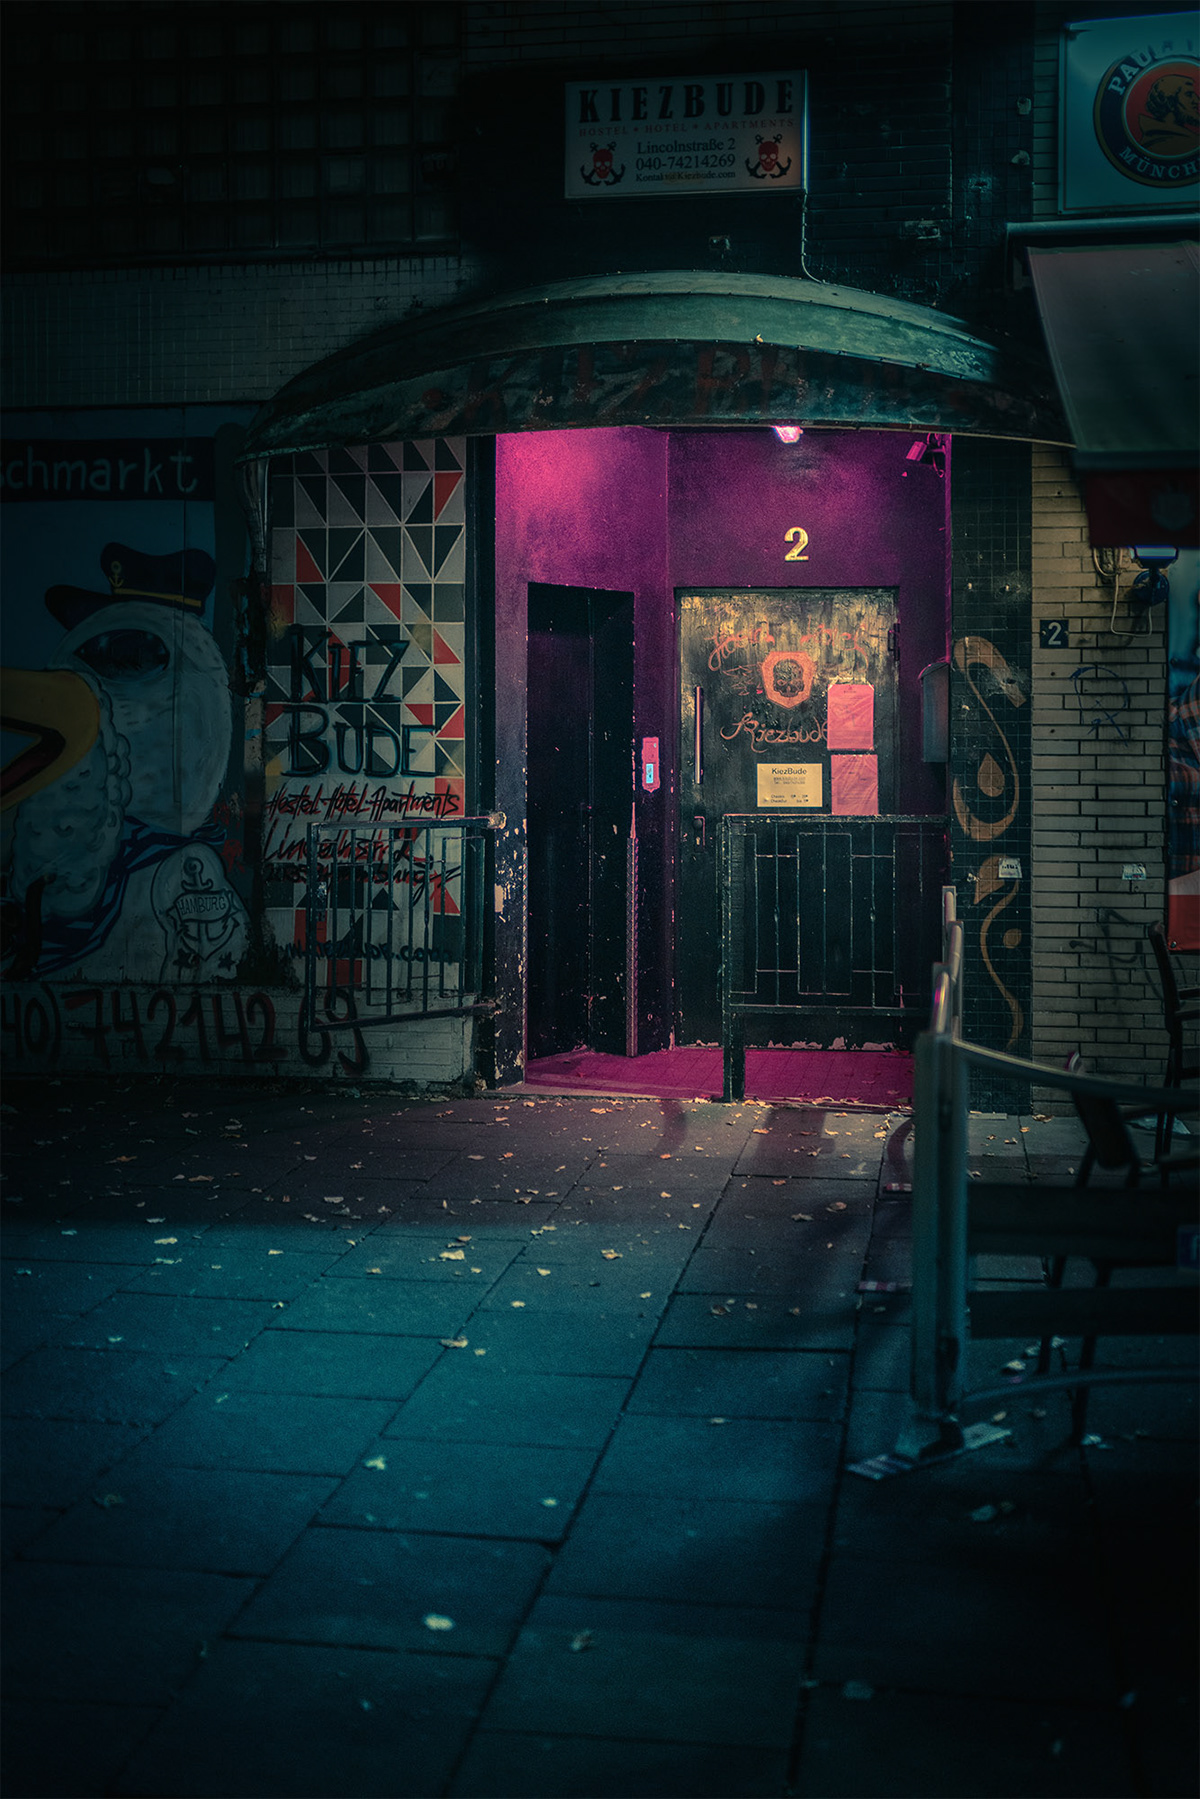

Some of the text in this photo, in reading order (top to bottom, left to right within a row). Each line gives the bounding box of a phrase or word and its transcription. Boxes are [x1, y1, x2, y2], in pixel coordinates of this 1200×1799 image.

[579, 80, 793, 123] KIEZBUDE
[579, 118, 794, 137] HOSTEL HOTEL APARTMENTS
[637, 137, 736, 155] Lincolnstraße 2
[636, 153, 736, 171] 040-74214269
[0, 445, 199, 493] chmarkt
[784, 526, 809, 562] 2
[1048, 621, 1062, 645] 2
[288, 623, 410, 703] KIEZ
[281, 703, 442, 778] BUDE
[178, 897, 226, 915] HAMBURG
